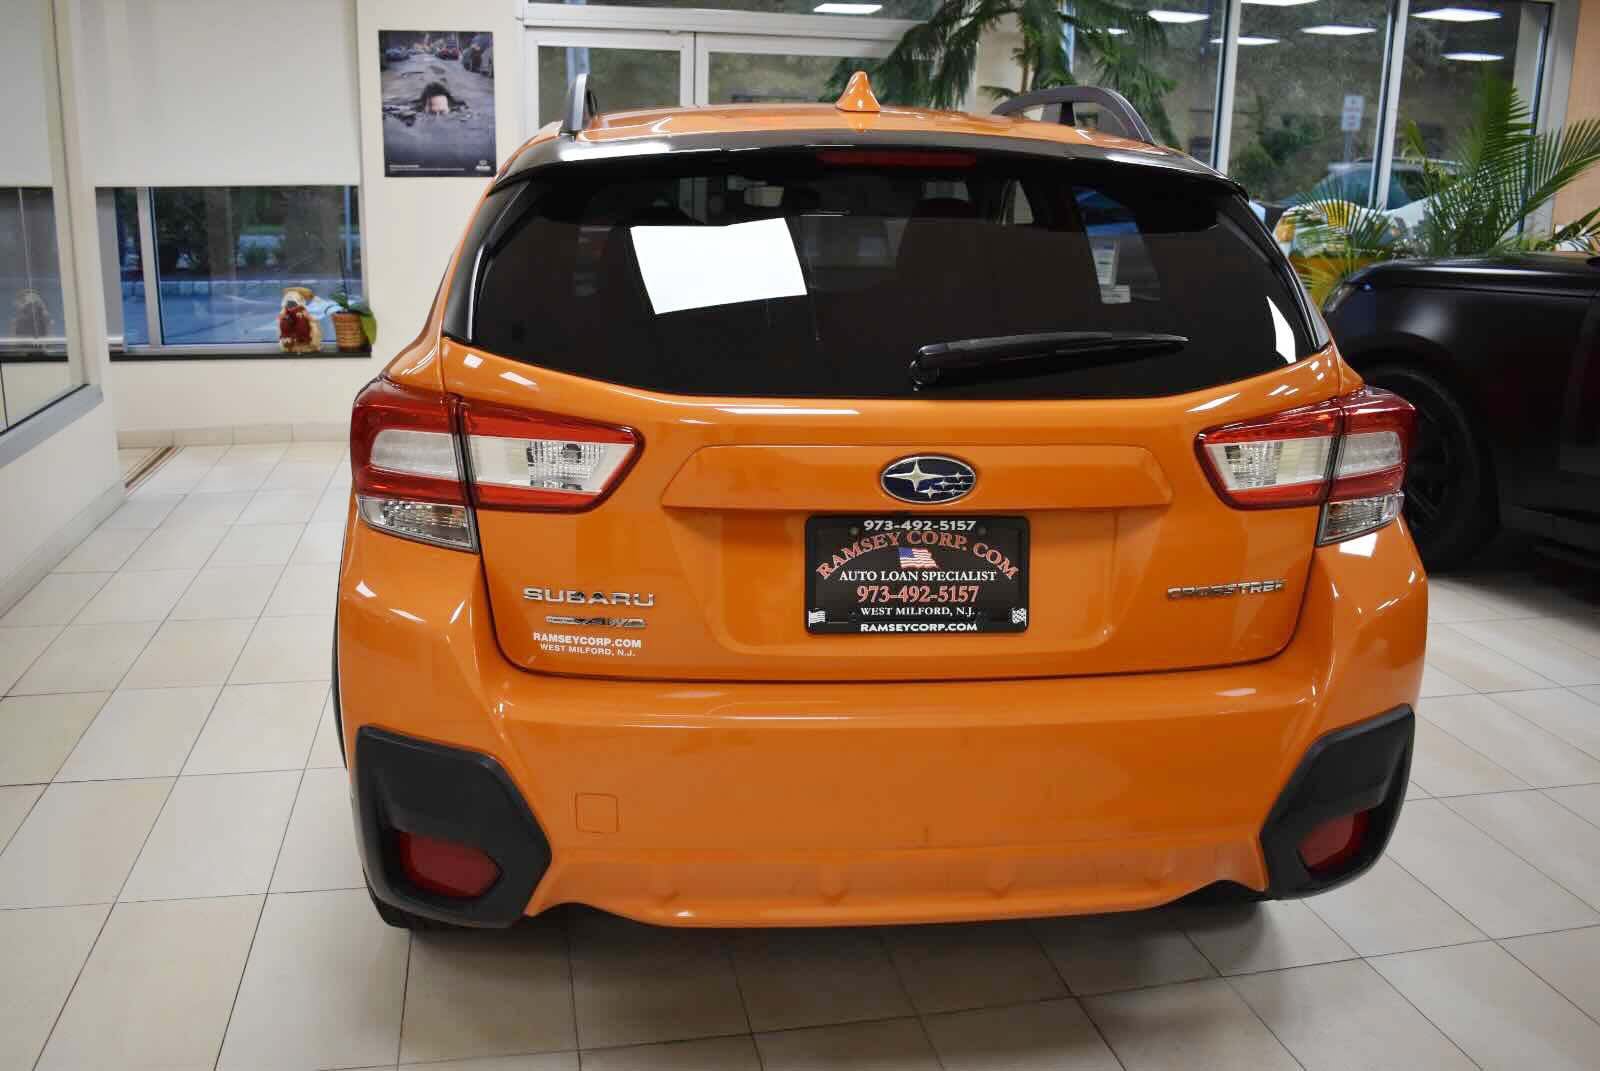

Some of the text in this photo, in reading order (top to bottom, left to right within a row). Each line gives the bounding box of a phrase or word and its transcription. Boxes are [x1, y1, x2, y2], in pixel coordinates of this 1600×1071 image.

[863, 520, 977, 532] 973-492-5157
[816, 531, 1020, 580] RAMSEY CORP. COM
[839, 571, 997, 582] AUTO LOAN SPECIALIST
[522, 586, 655, 607] SUBARU
[856, 585, 980, 604] 973-492-5157
[860, 607, 976, 617] WEST MILFORD, N.J.
[860, 623, 978, 632] RAMSEYCORP.COM
[532, 632, 642, 649] RAMSEYCORP.COM
[540, 643, 566, 652] WEST
